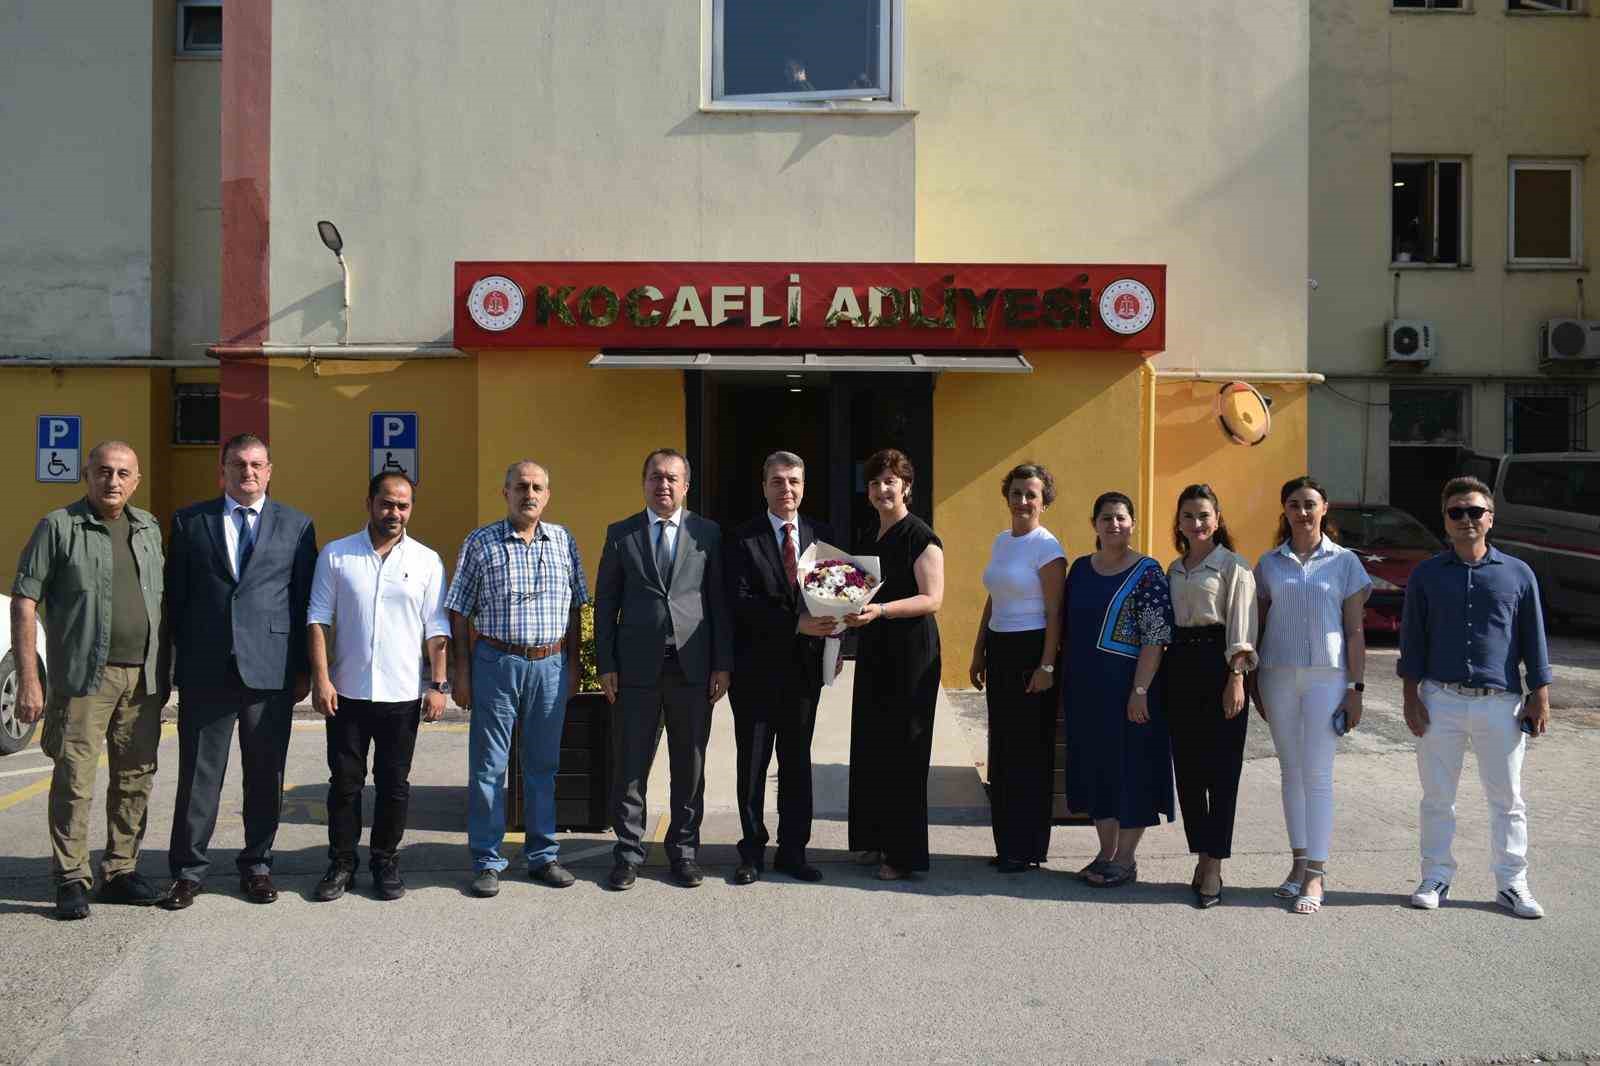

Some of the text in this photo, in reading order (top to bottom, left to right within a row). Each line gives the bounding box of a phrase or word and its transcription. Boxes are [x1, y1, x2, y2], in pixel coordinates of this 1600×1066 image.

[825, 273, 1092, 329] ADLİYESİ
[49, 420, 69, 447] P
[384, 417, 404, 446] P
